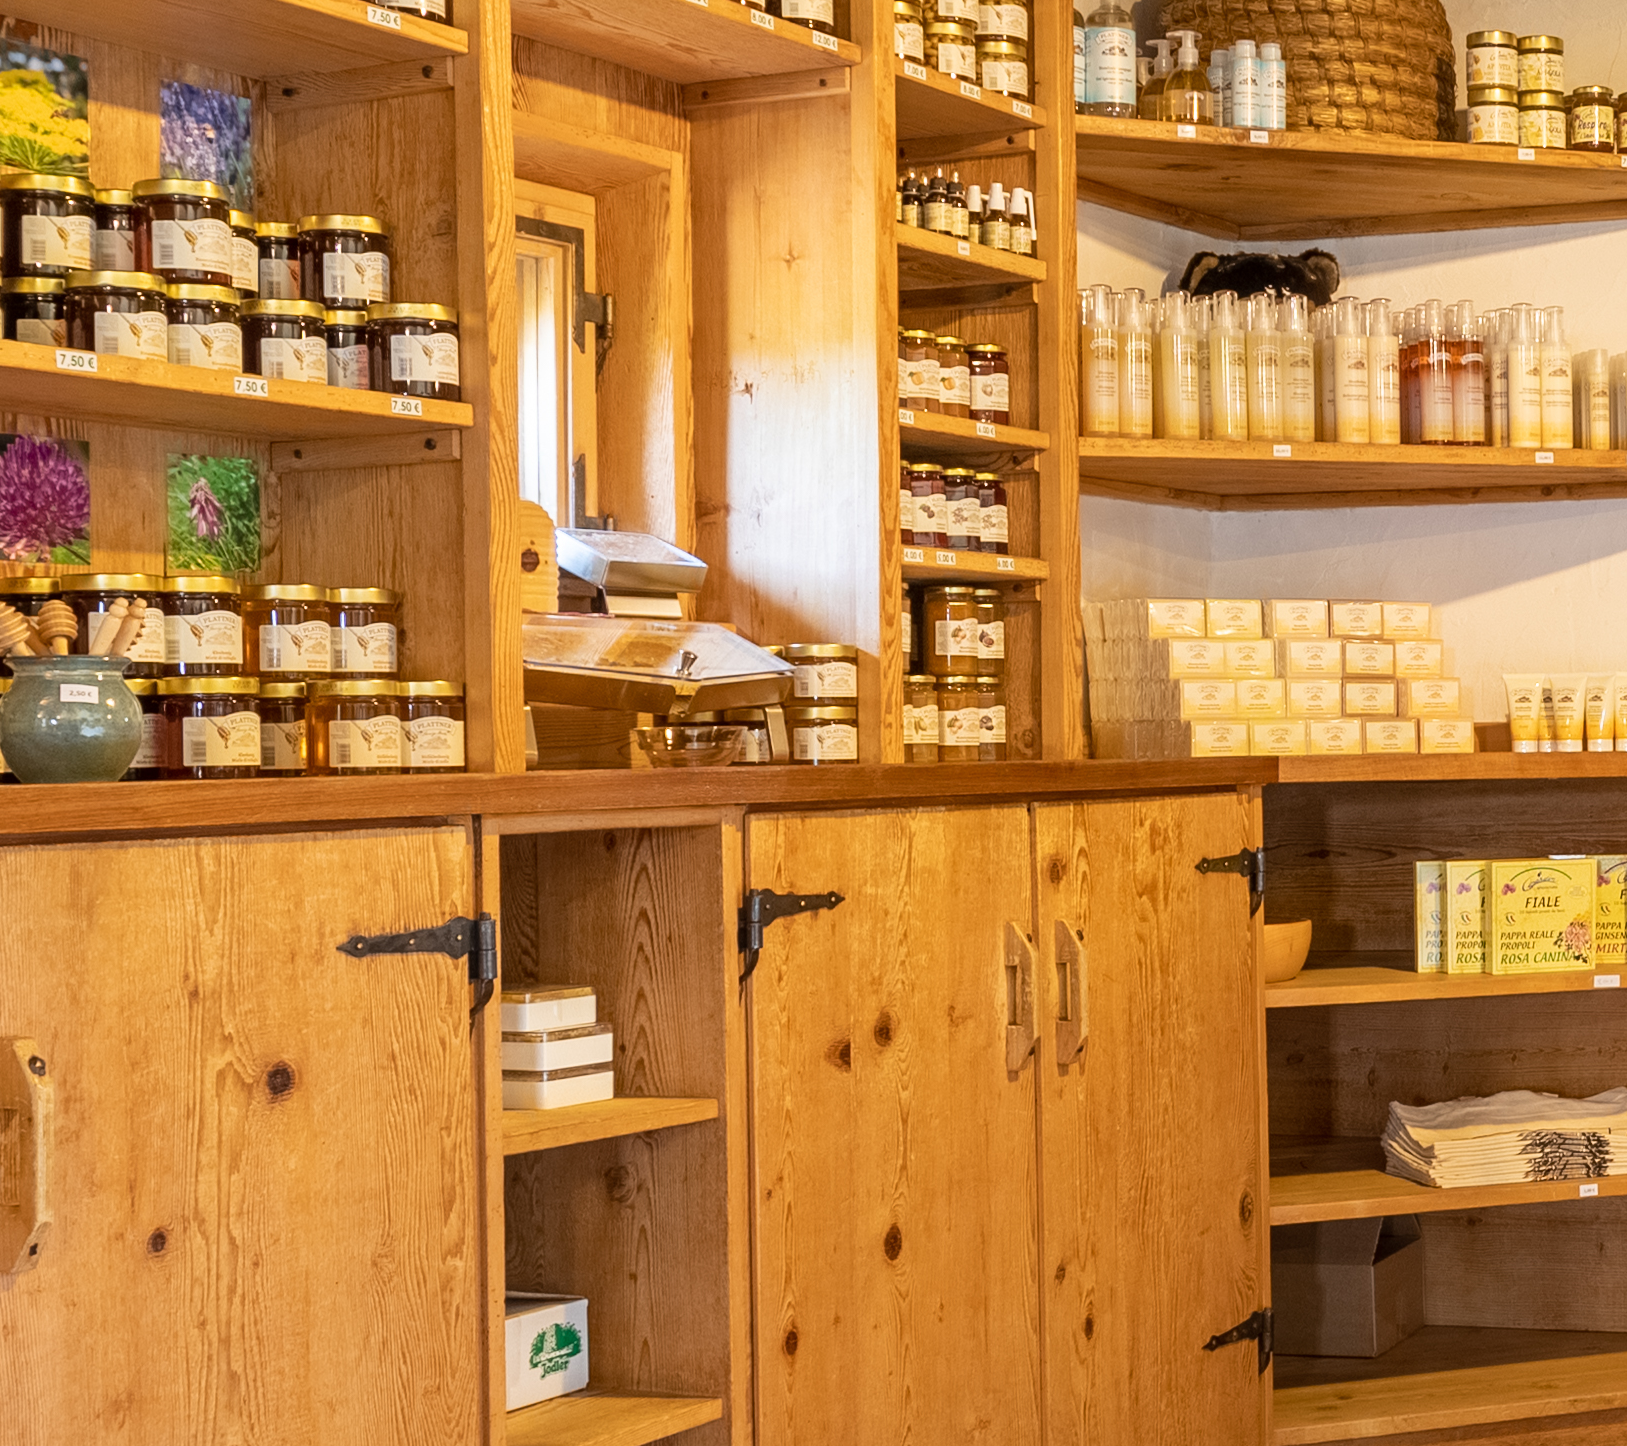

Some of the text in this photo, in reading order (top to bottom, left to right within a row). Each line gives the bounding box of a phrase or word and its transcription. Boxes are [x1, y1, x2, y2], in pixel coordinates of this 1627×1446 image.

[59, 354, 95, 369] 7,50 €
[235, 379, 267, 394] 7,50 €
[392, 400, 420, 413] 7,50 €
[1525, 896, 1561, 908] FIALE
[1596, 922, 1622, 930] PAPPA
[1456, 931, 1483, 940] PAPPA
[1501, 930, 1554, 940] PAPPA REALE
[1500, 942, 1535, 951] PROPOLI
[1456, 953, 1486, 964] ROSA
[1501, 951, 1577, 965] ROSA CANINA
[541, 1361, 569, 1379] Jodler
